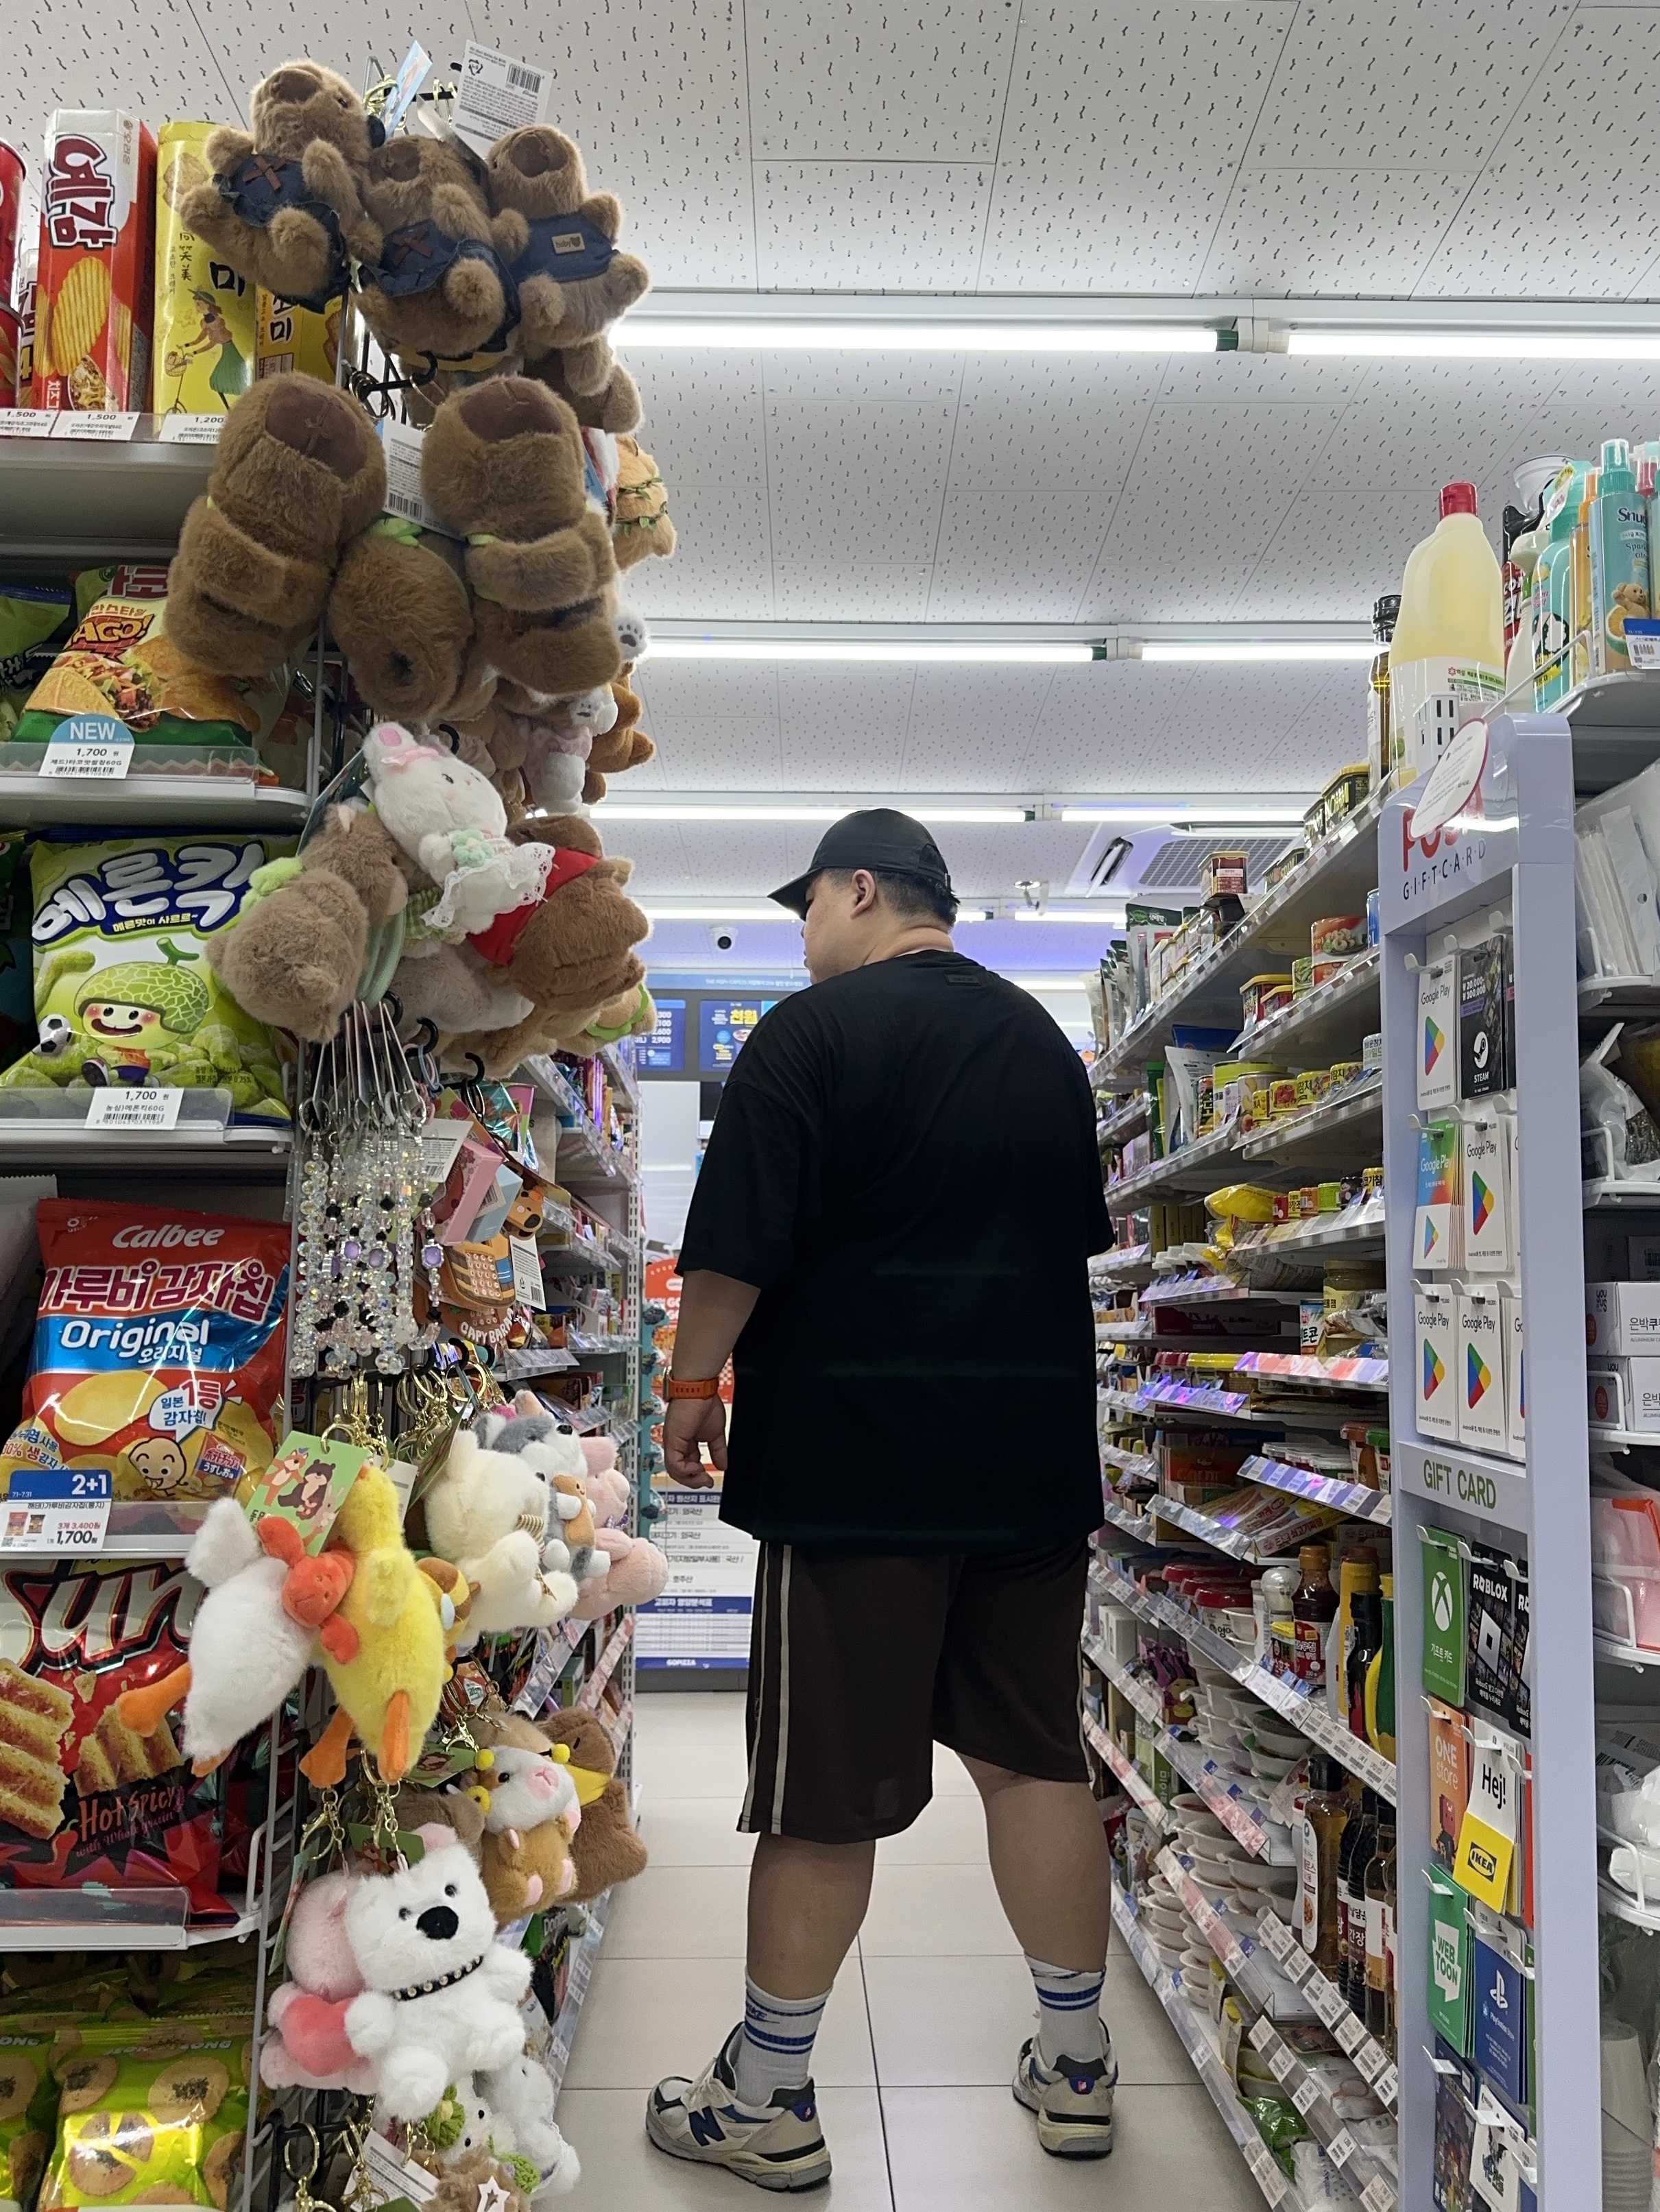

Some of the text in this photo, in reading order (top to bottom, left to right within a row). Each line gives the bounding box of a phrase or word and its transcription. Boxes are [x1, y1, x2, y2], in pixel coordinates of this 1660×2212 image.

[49, 136, 115, 245] 예감
[73, 614, 154, 642] ACO!
[70, 722, 116, 741] NEW
[77, 748, 108, 757] 1,700
[32, 841, 265, 941] 메론킥
[112, 912, 198, 933] 메론맛이 사르르~
[1421, 985, 1450, 1005] Google Play
[1474, 1073, 1489, 1083] STEAM
[125, 1091, 157, 1101] 1,700
[1467, 1140, 1497, 1159] Google Play
[1421, 1154, 1452, 1175] Google Play
[112, 1224, 226, 1249] Calbee
[1418, 1311, 1449, 1330] Google Play
[1463, 1314, 1495, 1333] Google Play
[60, 1317, 209, 1358] Original
[138, 1345, 203, 1364] 오리지널
[161, 1380, 221, 1410] 일본 1등
[164, 1410, 206, 1426] 감자칩!
[1, 1443, 23, 1457] 00%
[71, 1474, 107, 1495] 2+1
[1423, 1459, 1496, 1509] GIFT CARD
[56, 1530, 97, 1545] 1,700원
[1473, 1574, 1508, 1602] ROBLOX
[1435, 1734, 1458, 1770] ONE
[1436, 1761, 1458, 1790] store
[1481, 1763, 1506, 1810] Hej!
[79, 1796, 122, 1842] Hot
[1471, 1850, 1495, 1875] IKEA
[1437, 1935, 1455, 1965] WEB
[1435, 1949, 1458, 1986] TOON
[688, 2108, 725, 2146] N
